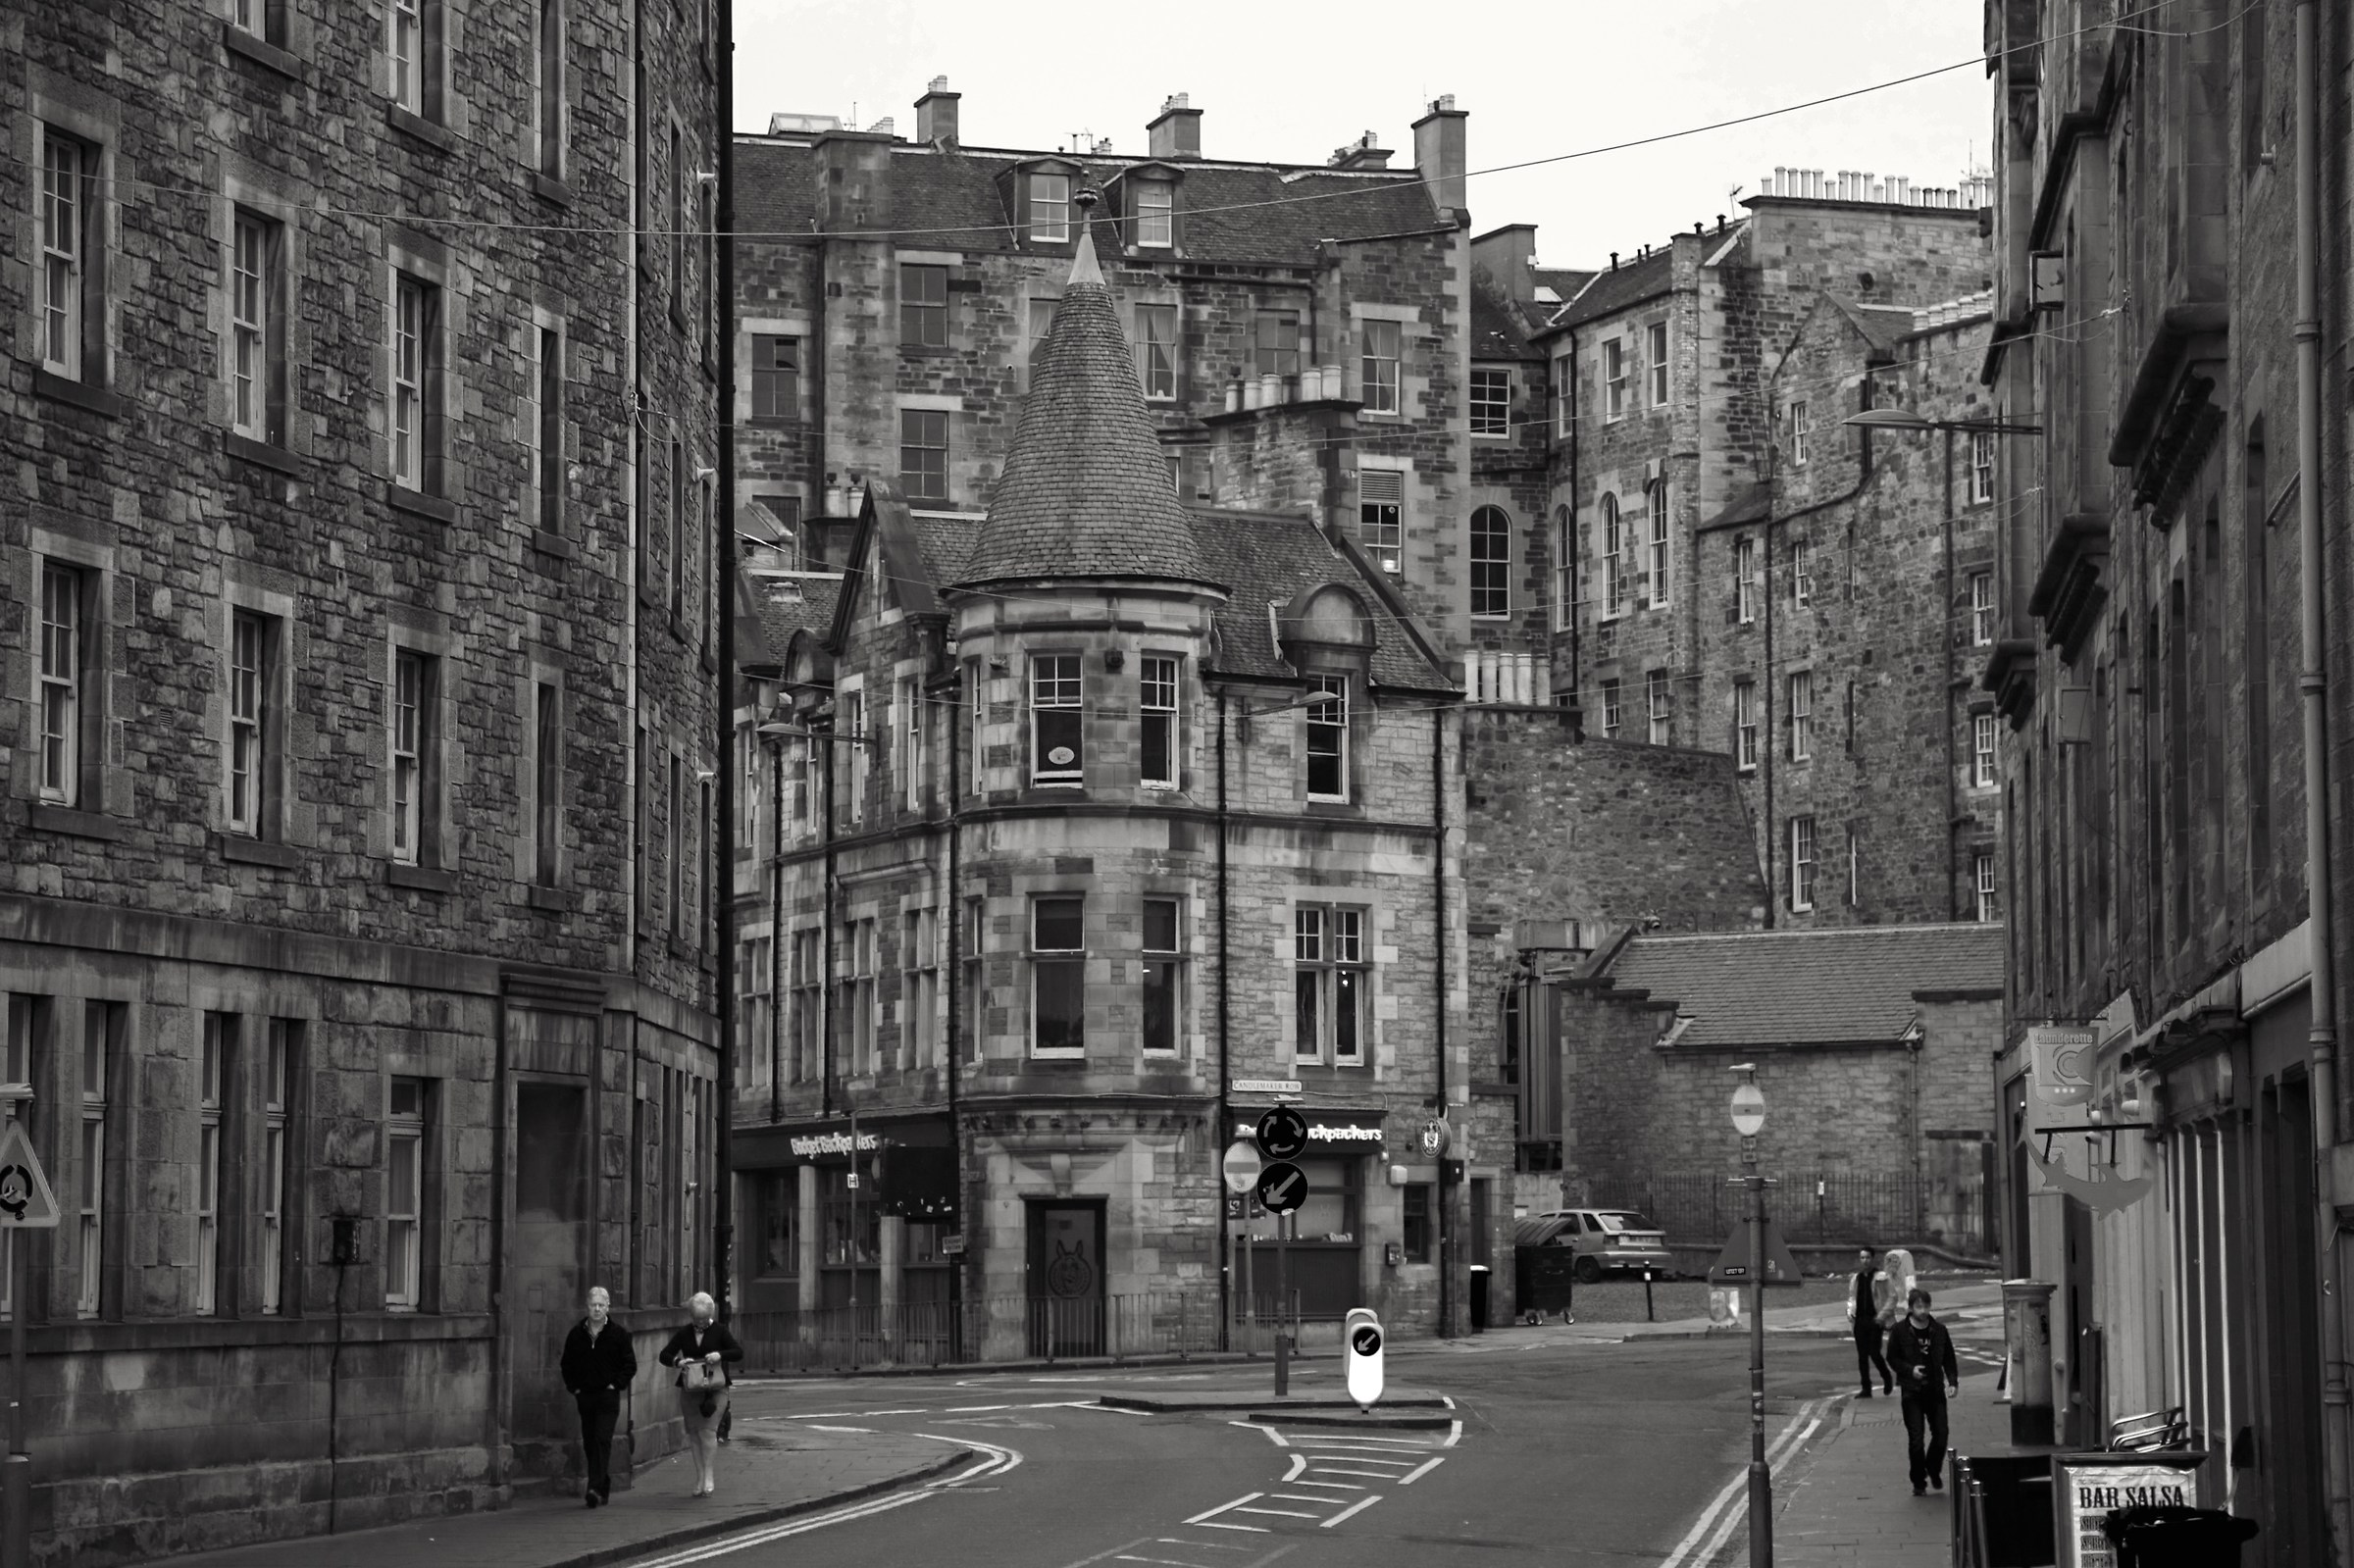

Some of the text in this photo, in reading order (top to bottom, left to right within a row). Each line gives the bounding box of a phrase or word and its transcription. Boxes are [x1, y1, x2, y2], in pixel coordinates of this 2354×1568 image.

[1233, 1082, 1283, 1090] CANDLEMAKER
[2079, 1486, 2184, 1509] BAR SALSA
